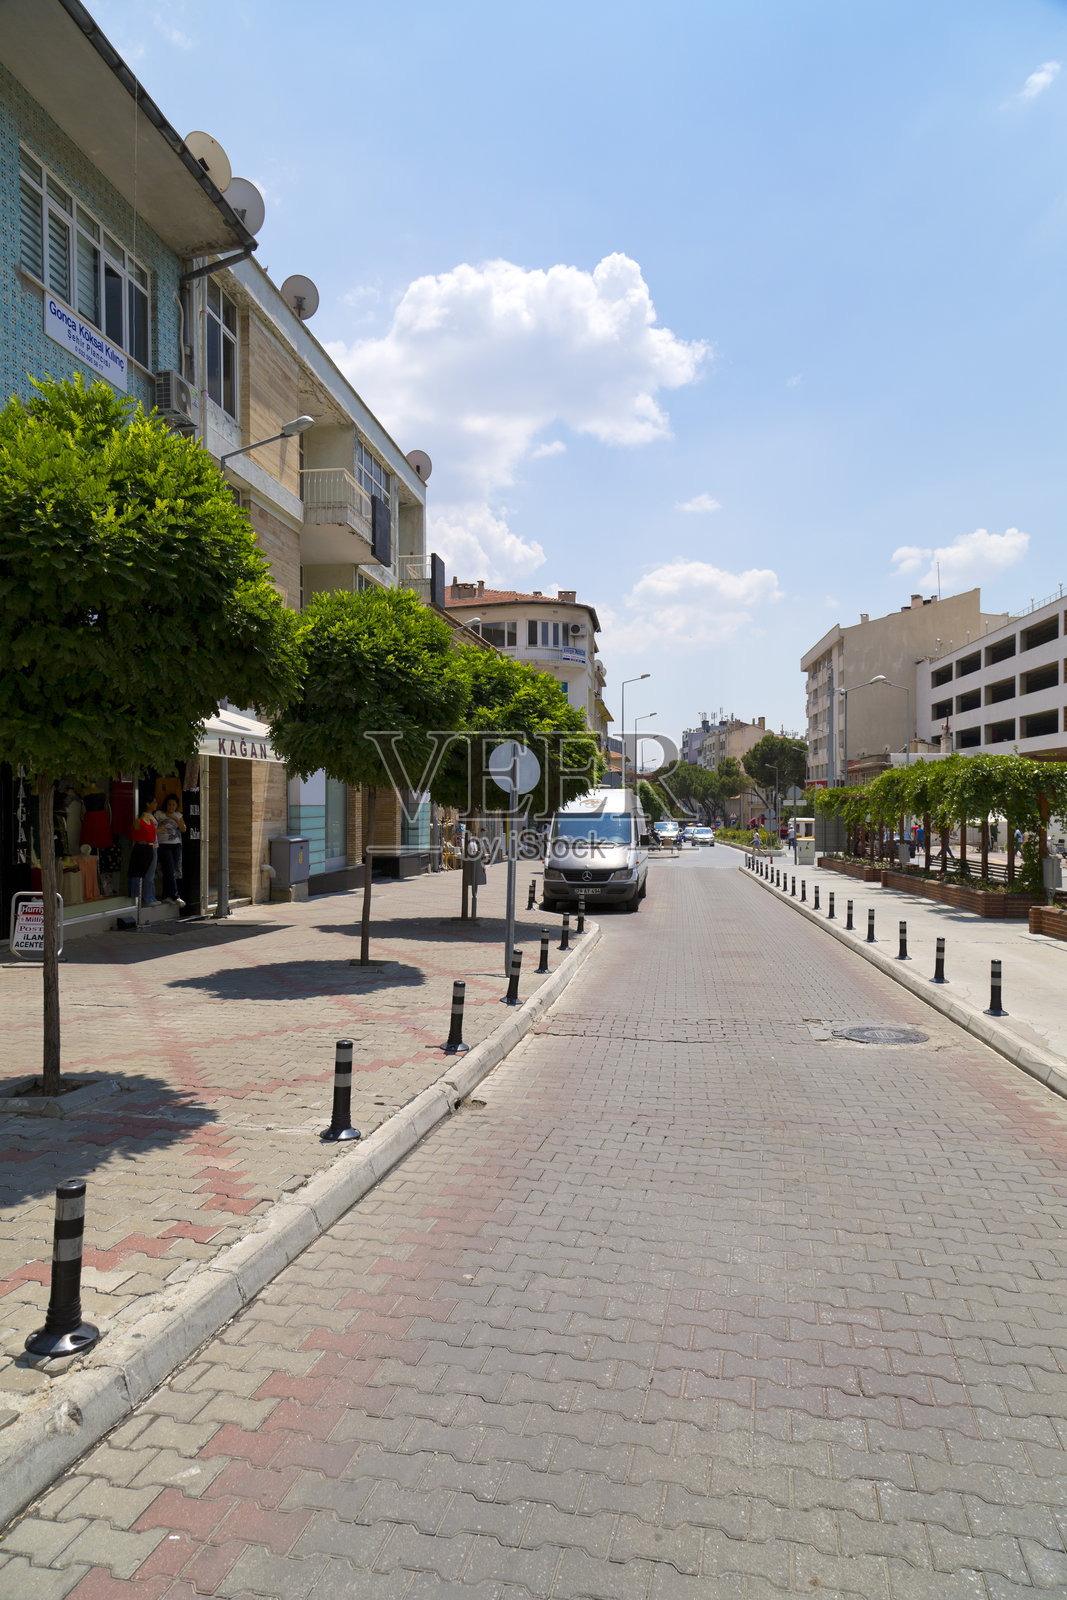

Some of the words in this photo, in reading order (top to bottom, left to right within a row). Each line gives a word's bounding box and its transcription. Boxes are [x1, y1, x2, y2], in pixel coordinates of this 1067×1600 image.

[50, 301, 76, 331] Gonca
[79, 324, 103, 353] Köksal
[218, 737, 267, 759] KAĞAN
[25, 916, 44, 924] Milliy
